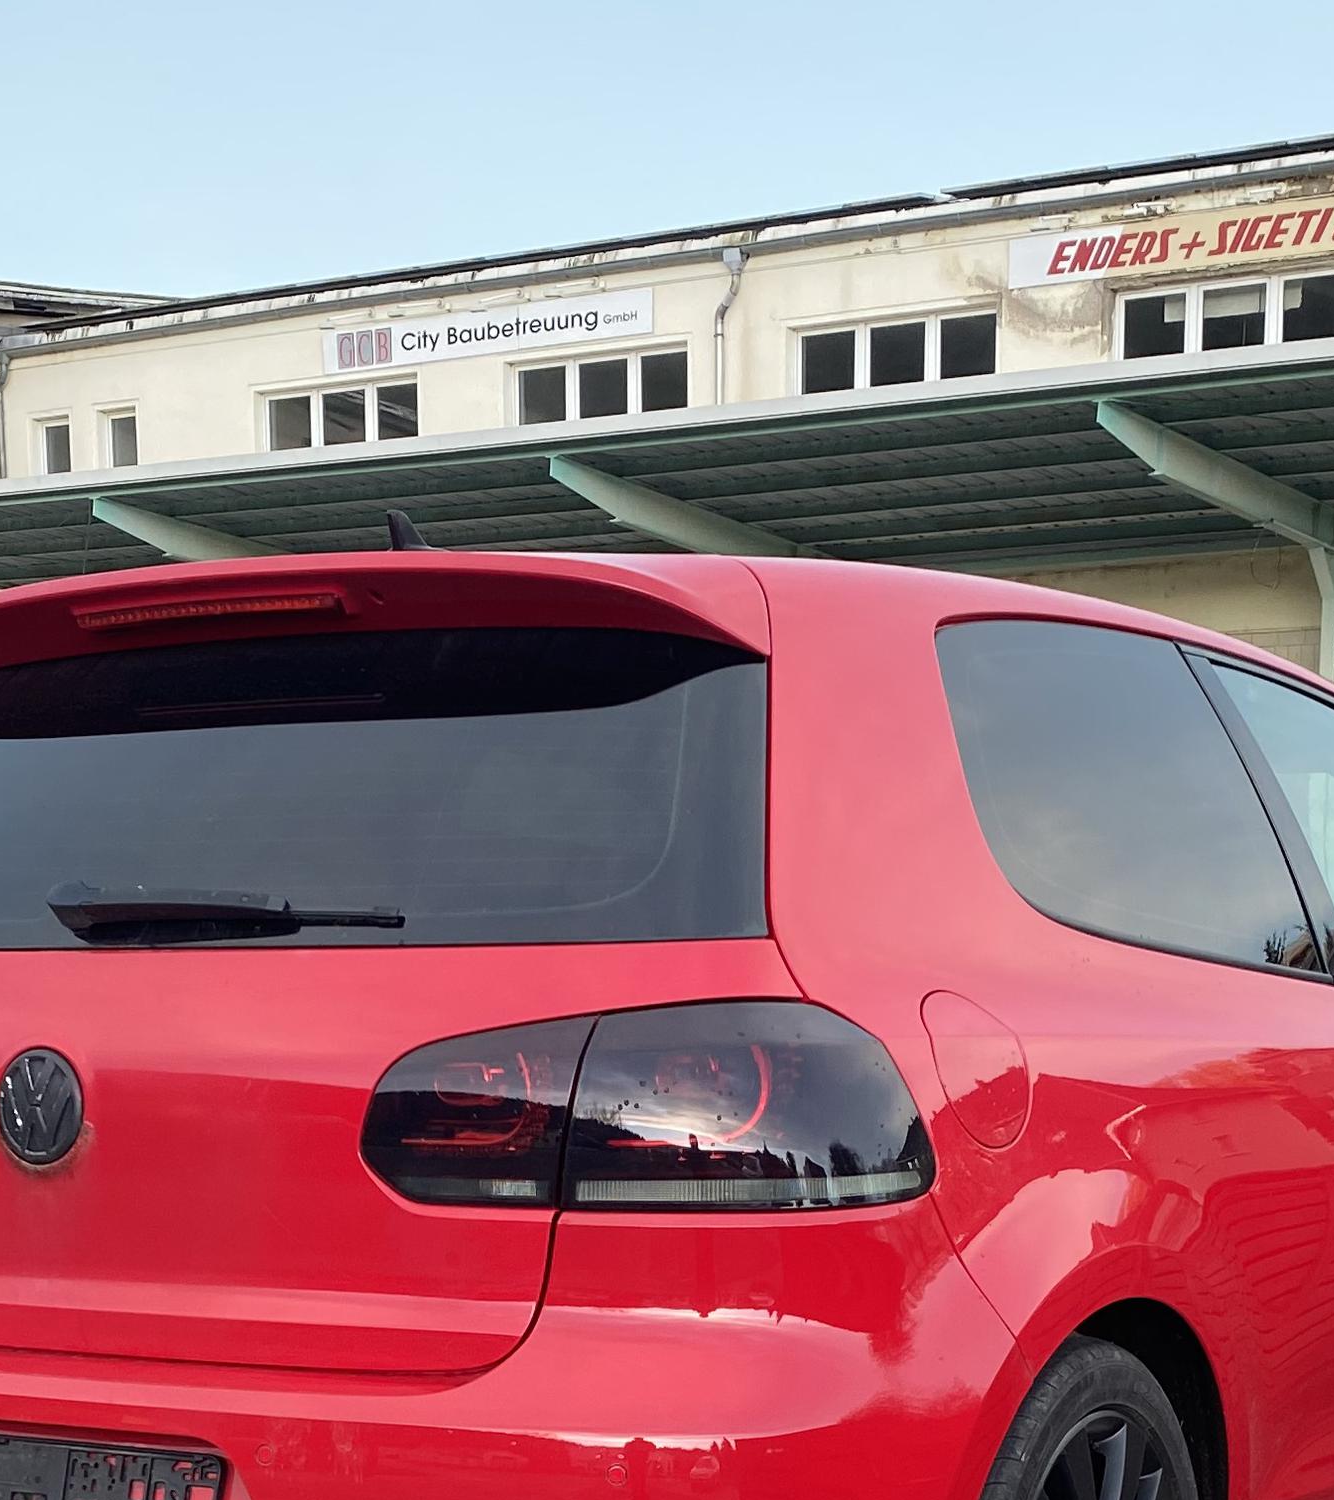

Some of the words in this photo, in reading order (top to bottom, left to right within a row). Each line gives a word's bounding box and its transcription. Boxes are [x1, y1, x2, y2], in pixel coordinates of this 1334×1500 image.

[1047, 227, 1179, 276] ENDERS
[1208, 207, 1334, 256] SIGETI
[337, 327, 392, 369] GCB
[400, 329, 441, 354] City
[447, 308, 599, 346] Baubetreuung
[603, 311, 638, 326] GmbH
